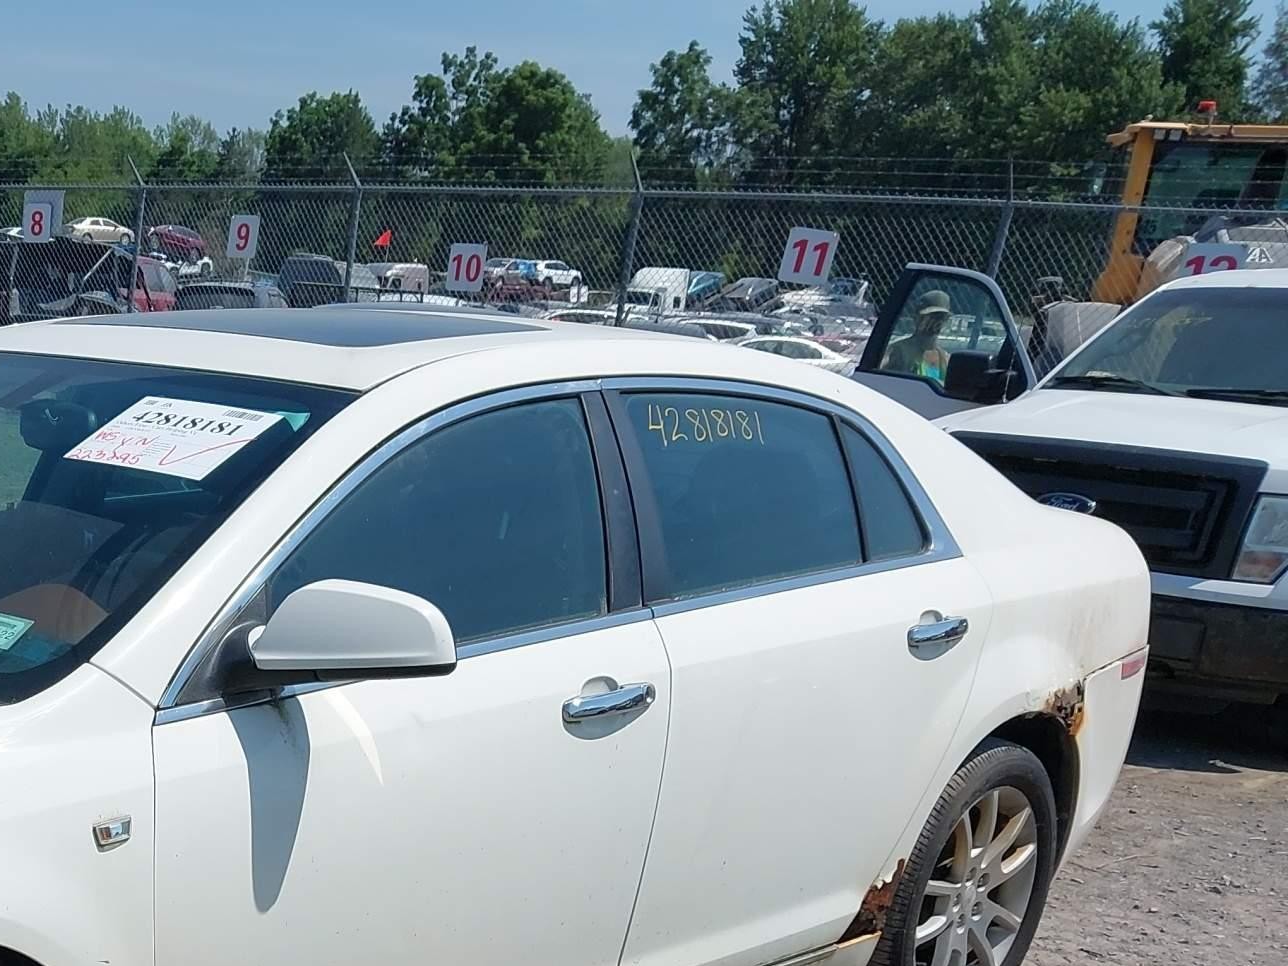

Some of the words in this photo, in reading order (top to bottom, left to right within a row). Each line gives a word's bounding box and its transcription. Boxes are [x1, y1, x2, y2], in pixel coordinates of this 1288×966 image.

[30, 210, 44, 237] 8
[235, 222, 250, 252] 9
[451, 252, 482, 283] 10
[792, 238, 830, 277] 11
[132, 410, 244, 436] 42818181
[648, 403, 765, 447] 42818181
